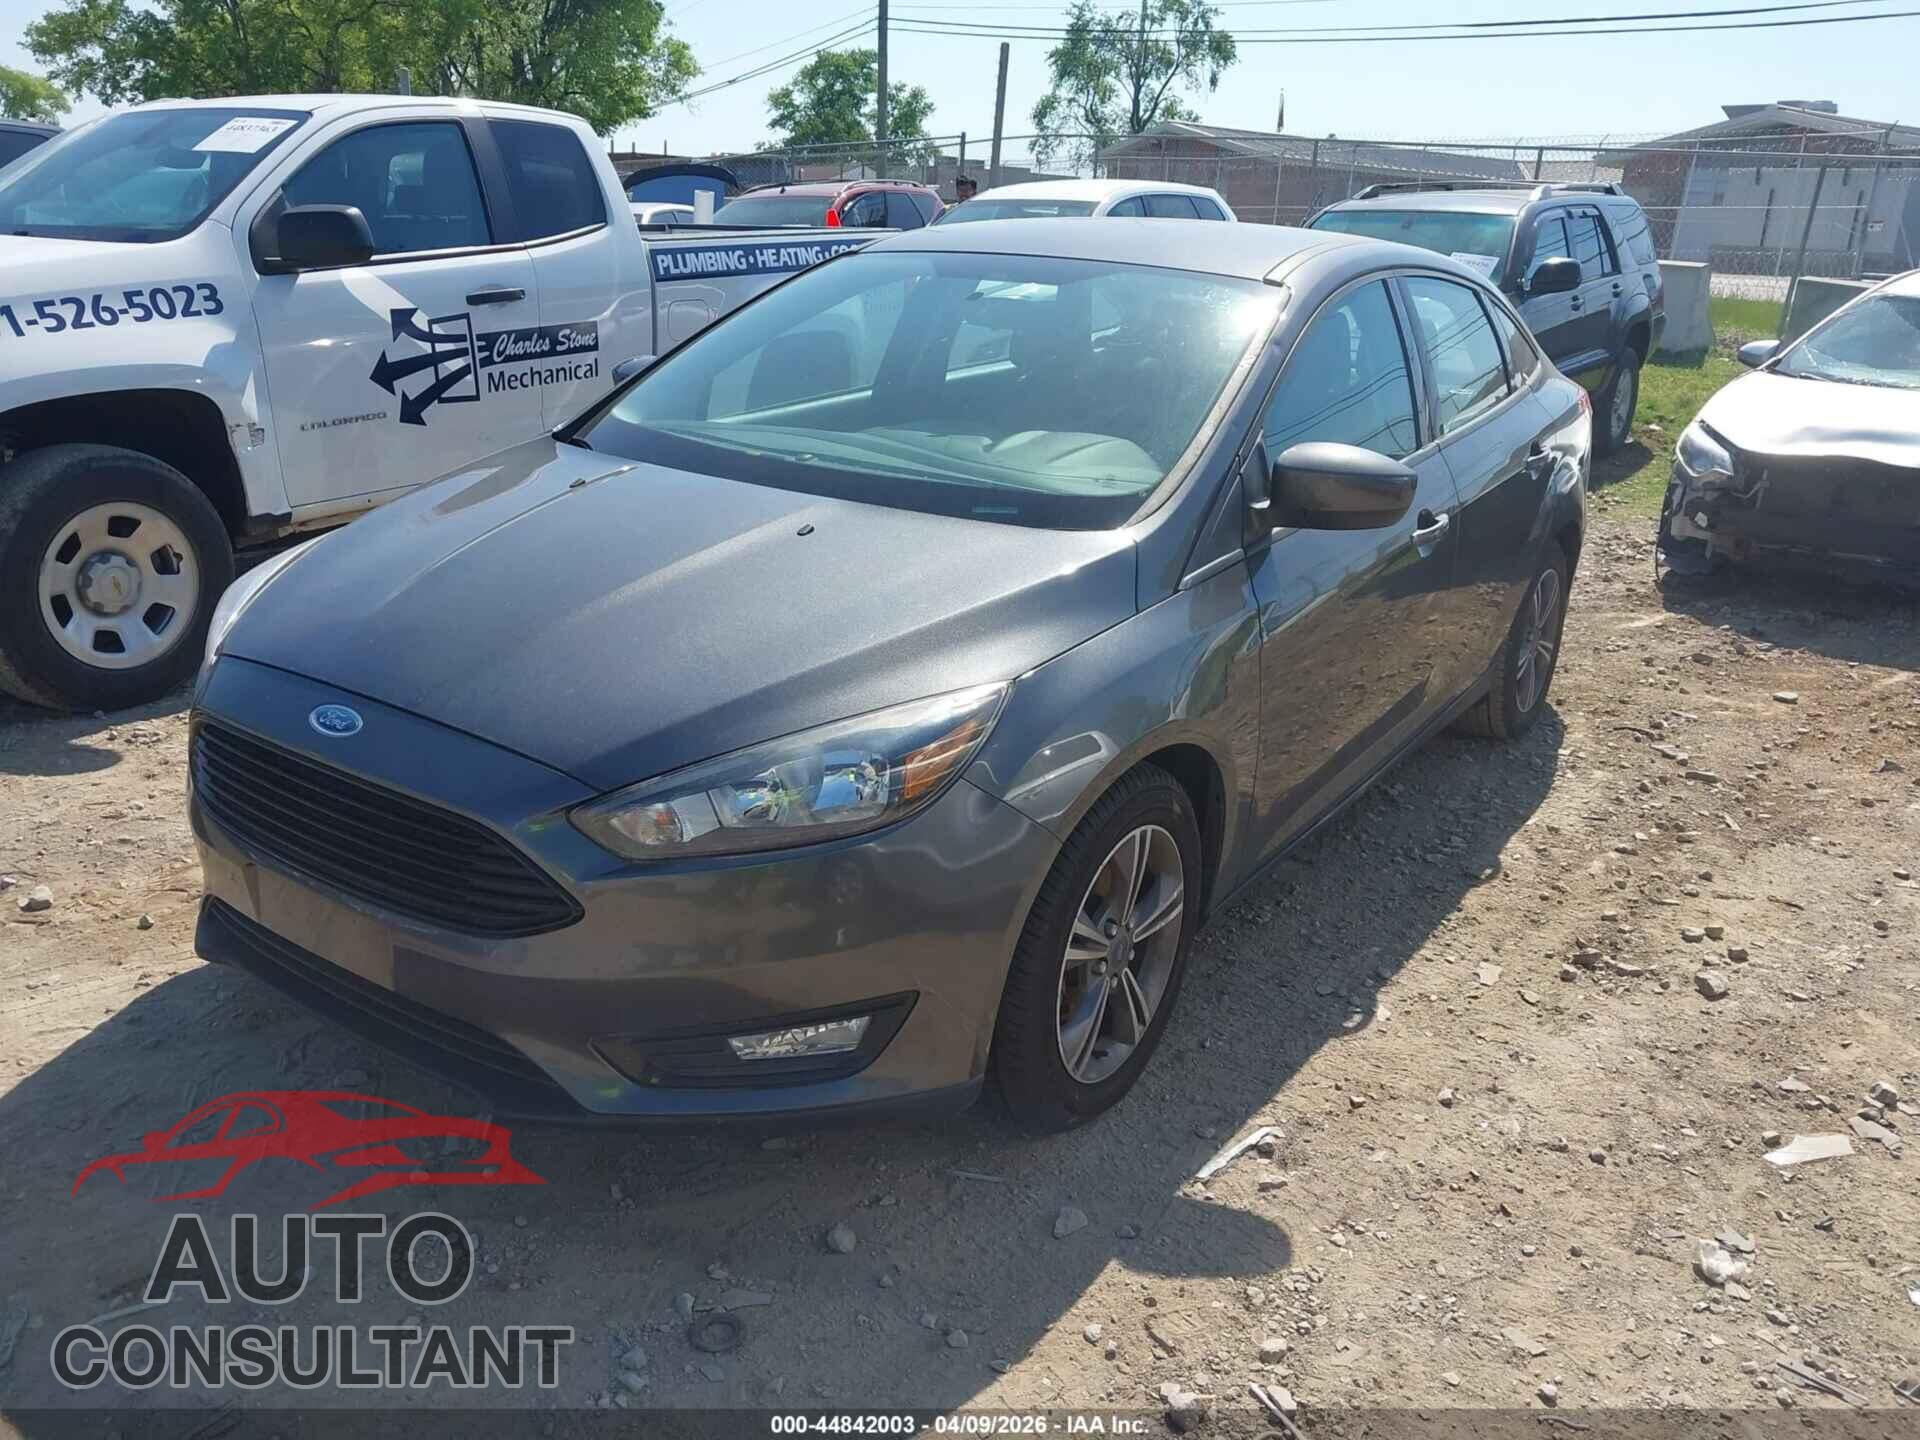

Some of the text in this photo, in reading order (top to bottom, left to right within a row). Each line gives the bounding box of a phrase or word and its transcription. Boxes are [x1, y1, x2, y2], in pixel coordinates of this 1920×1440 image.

[656, 251, 747, 275] PLUMBING
[757, 246, 822, 268] HEATING
[0, 283, 224, 337] 1-526-5023
[493, 328, 597, 362] Charles Stone
[487, 358, 599, 393] Mechanical
